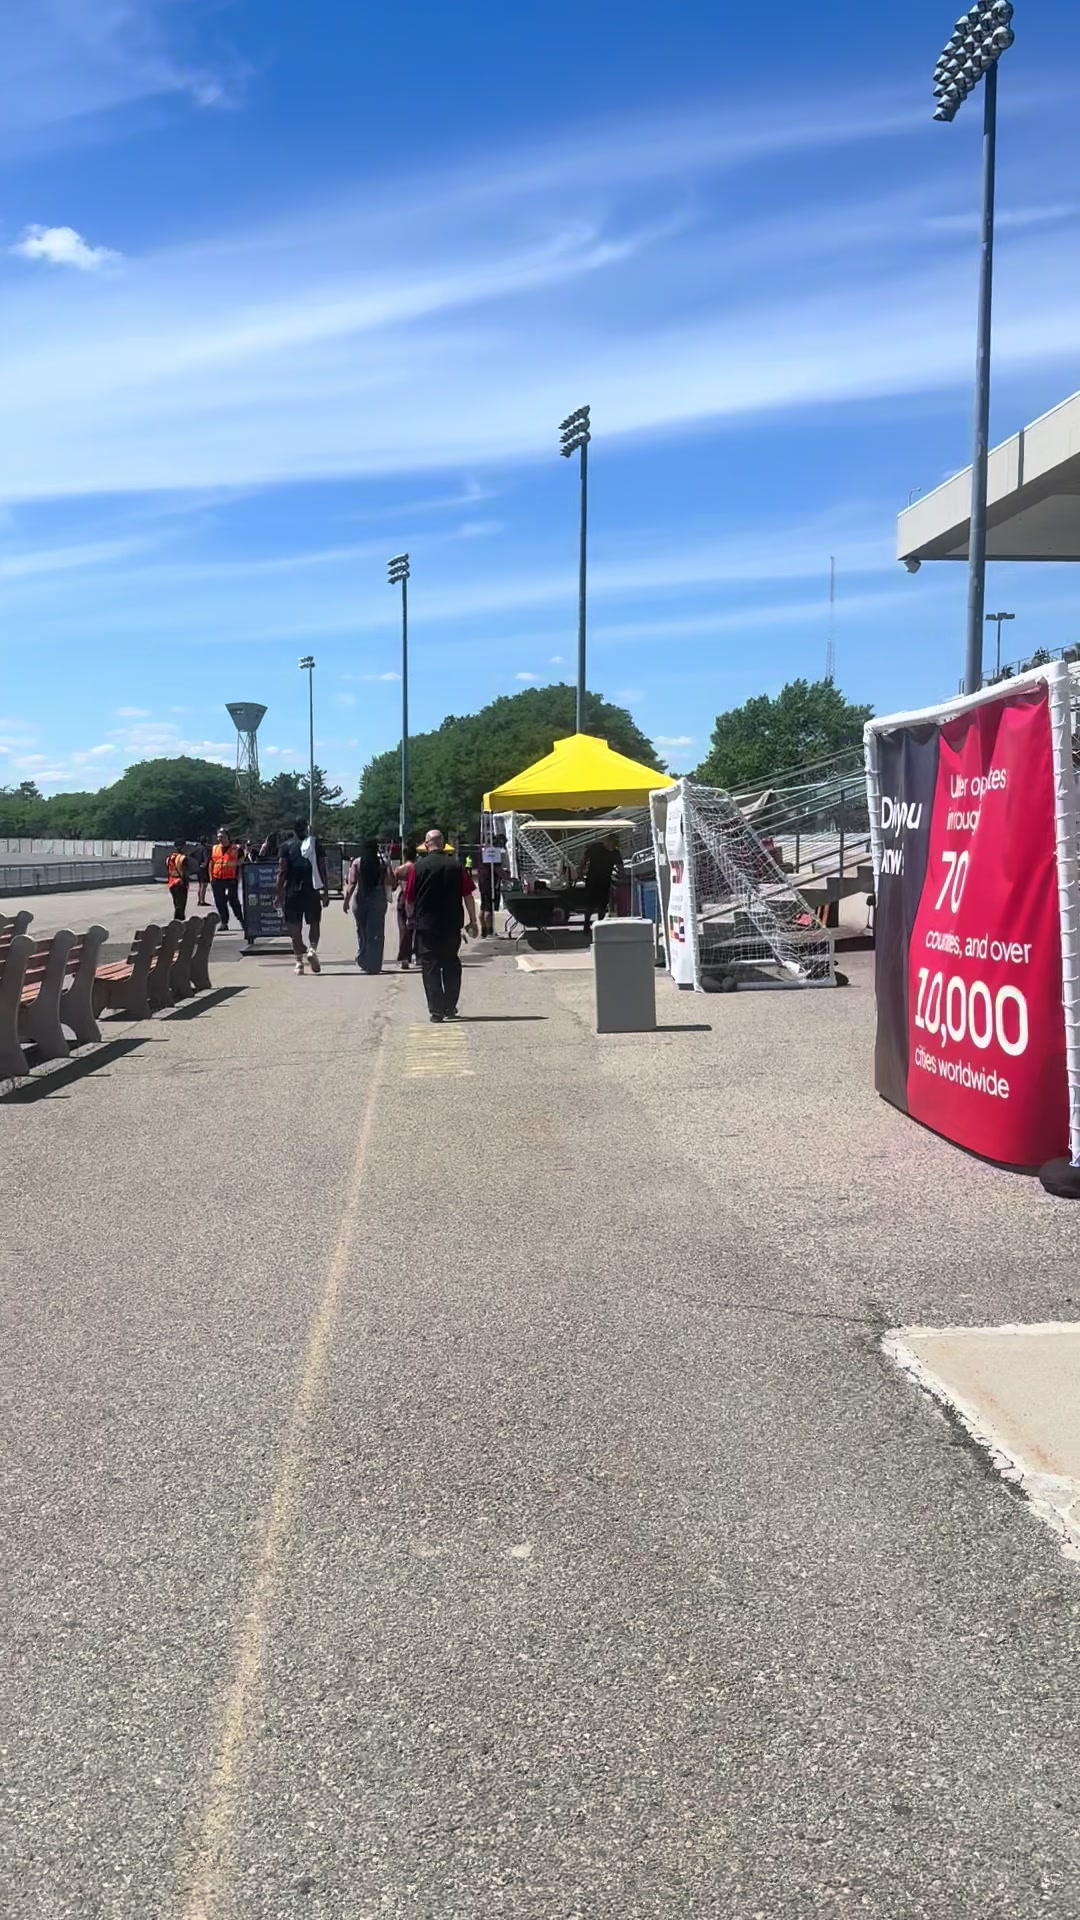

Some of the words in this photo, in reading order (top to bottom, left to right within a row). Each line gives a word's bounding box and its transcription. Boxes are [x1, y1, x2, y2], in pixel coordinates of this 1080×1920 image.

[949, 773, 969, 799] Uer
[970, 765, 1007, 801] optes
[934, 850, 969, 914] 70
[964, 933, 989, 959] and
[990, 940, 1033, 964] over
[915, 967, 1029, 1056] 10,000
[937, 1059, 1010, 1099] worldwide
